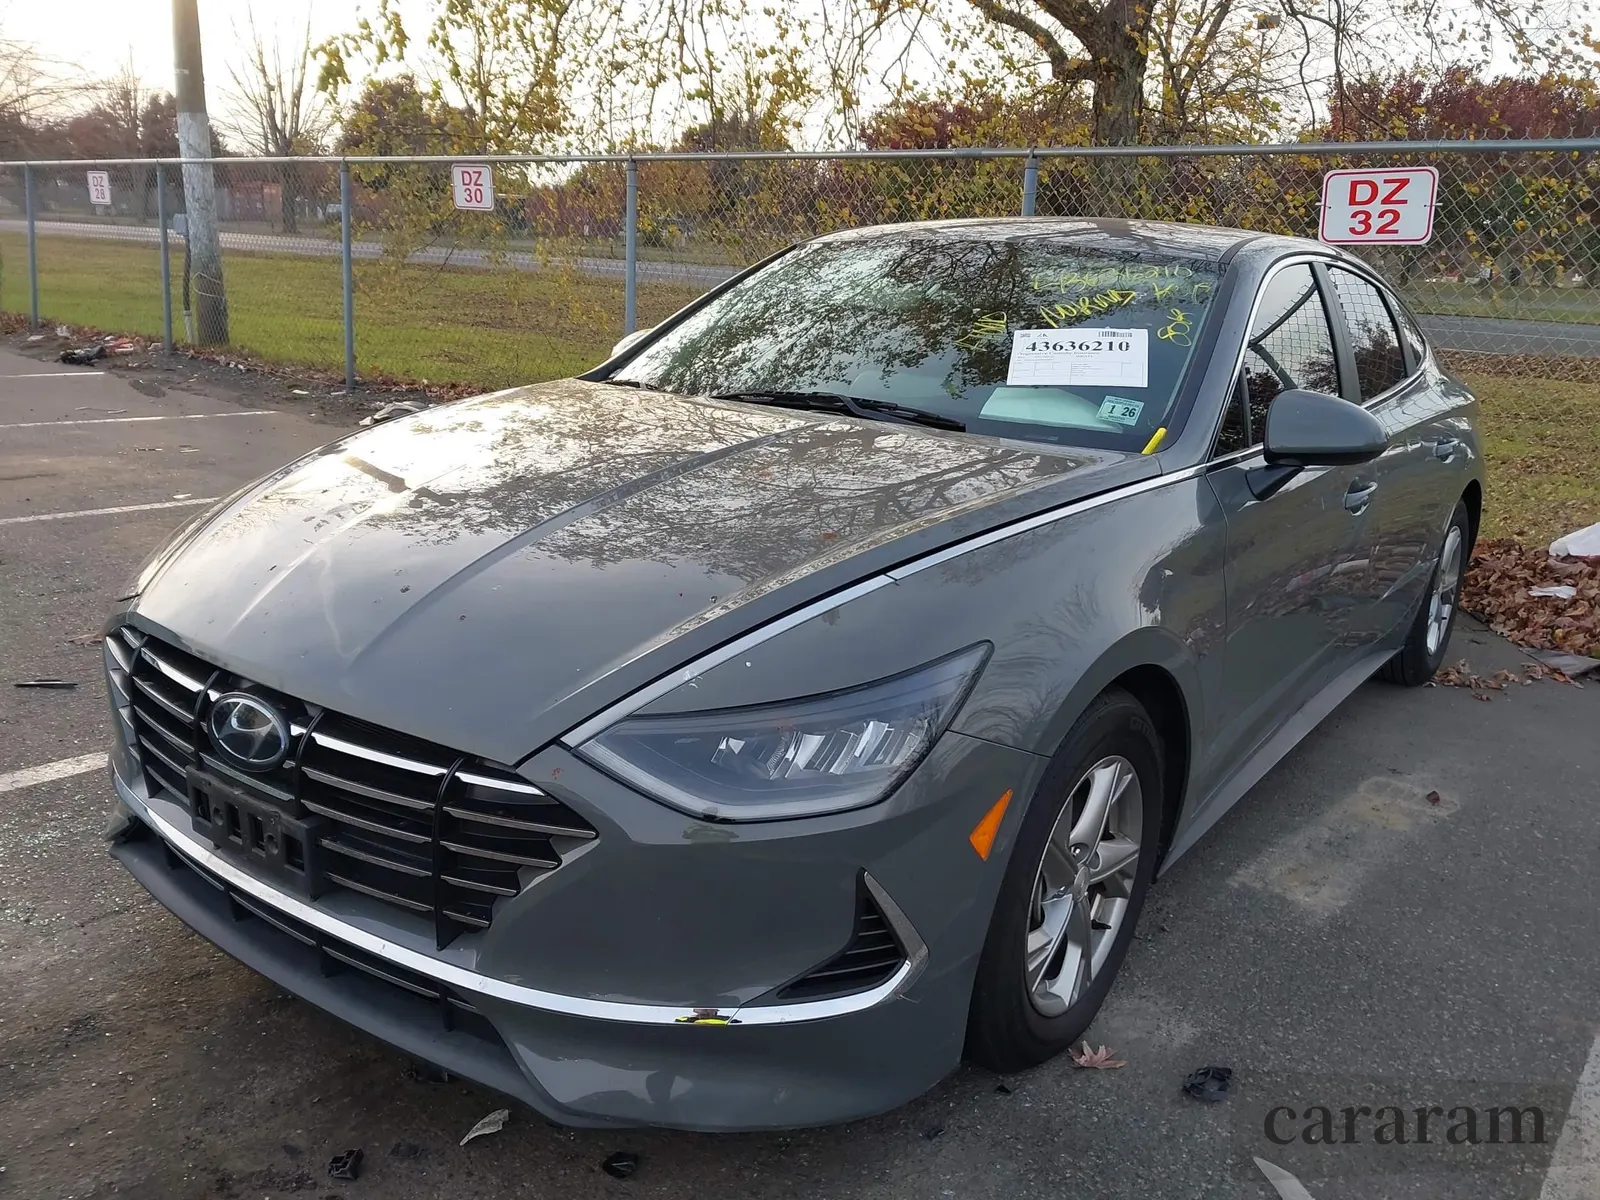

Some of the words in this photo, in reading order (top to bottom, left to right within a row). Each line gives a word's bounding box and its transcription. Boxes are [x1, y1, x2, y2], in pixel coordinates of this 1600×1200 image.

[92, 175, 104, 188] DZ
[461, 170, 483, 187] DZ
[95, 188, 106, 200] 28
[464, 188, 483, 204] 30
[1348, 178, 1411, 206] DZ
[1348, 208, 1401, 236] 32
[1025, 340, 1130, 352] 43636210
[1107, 404, 1116, 415] 1
[1121, 406, 1137, 418] 26
